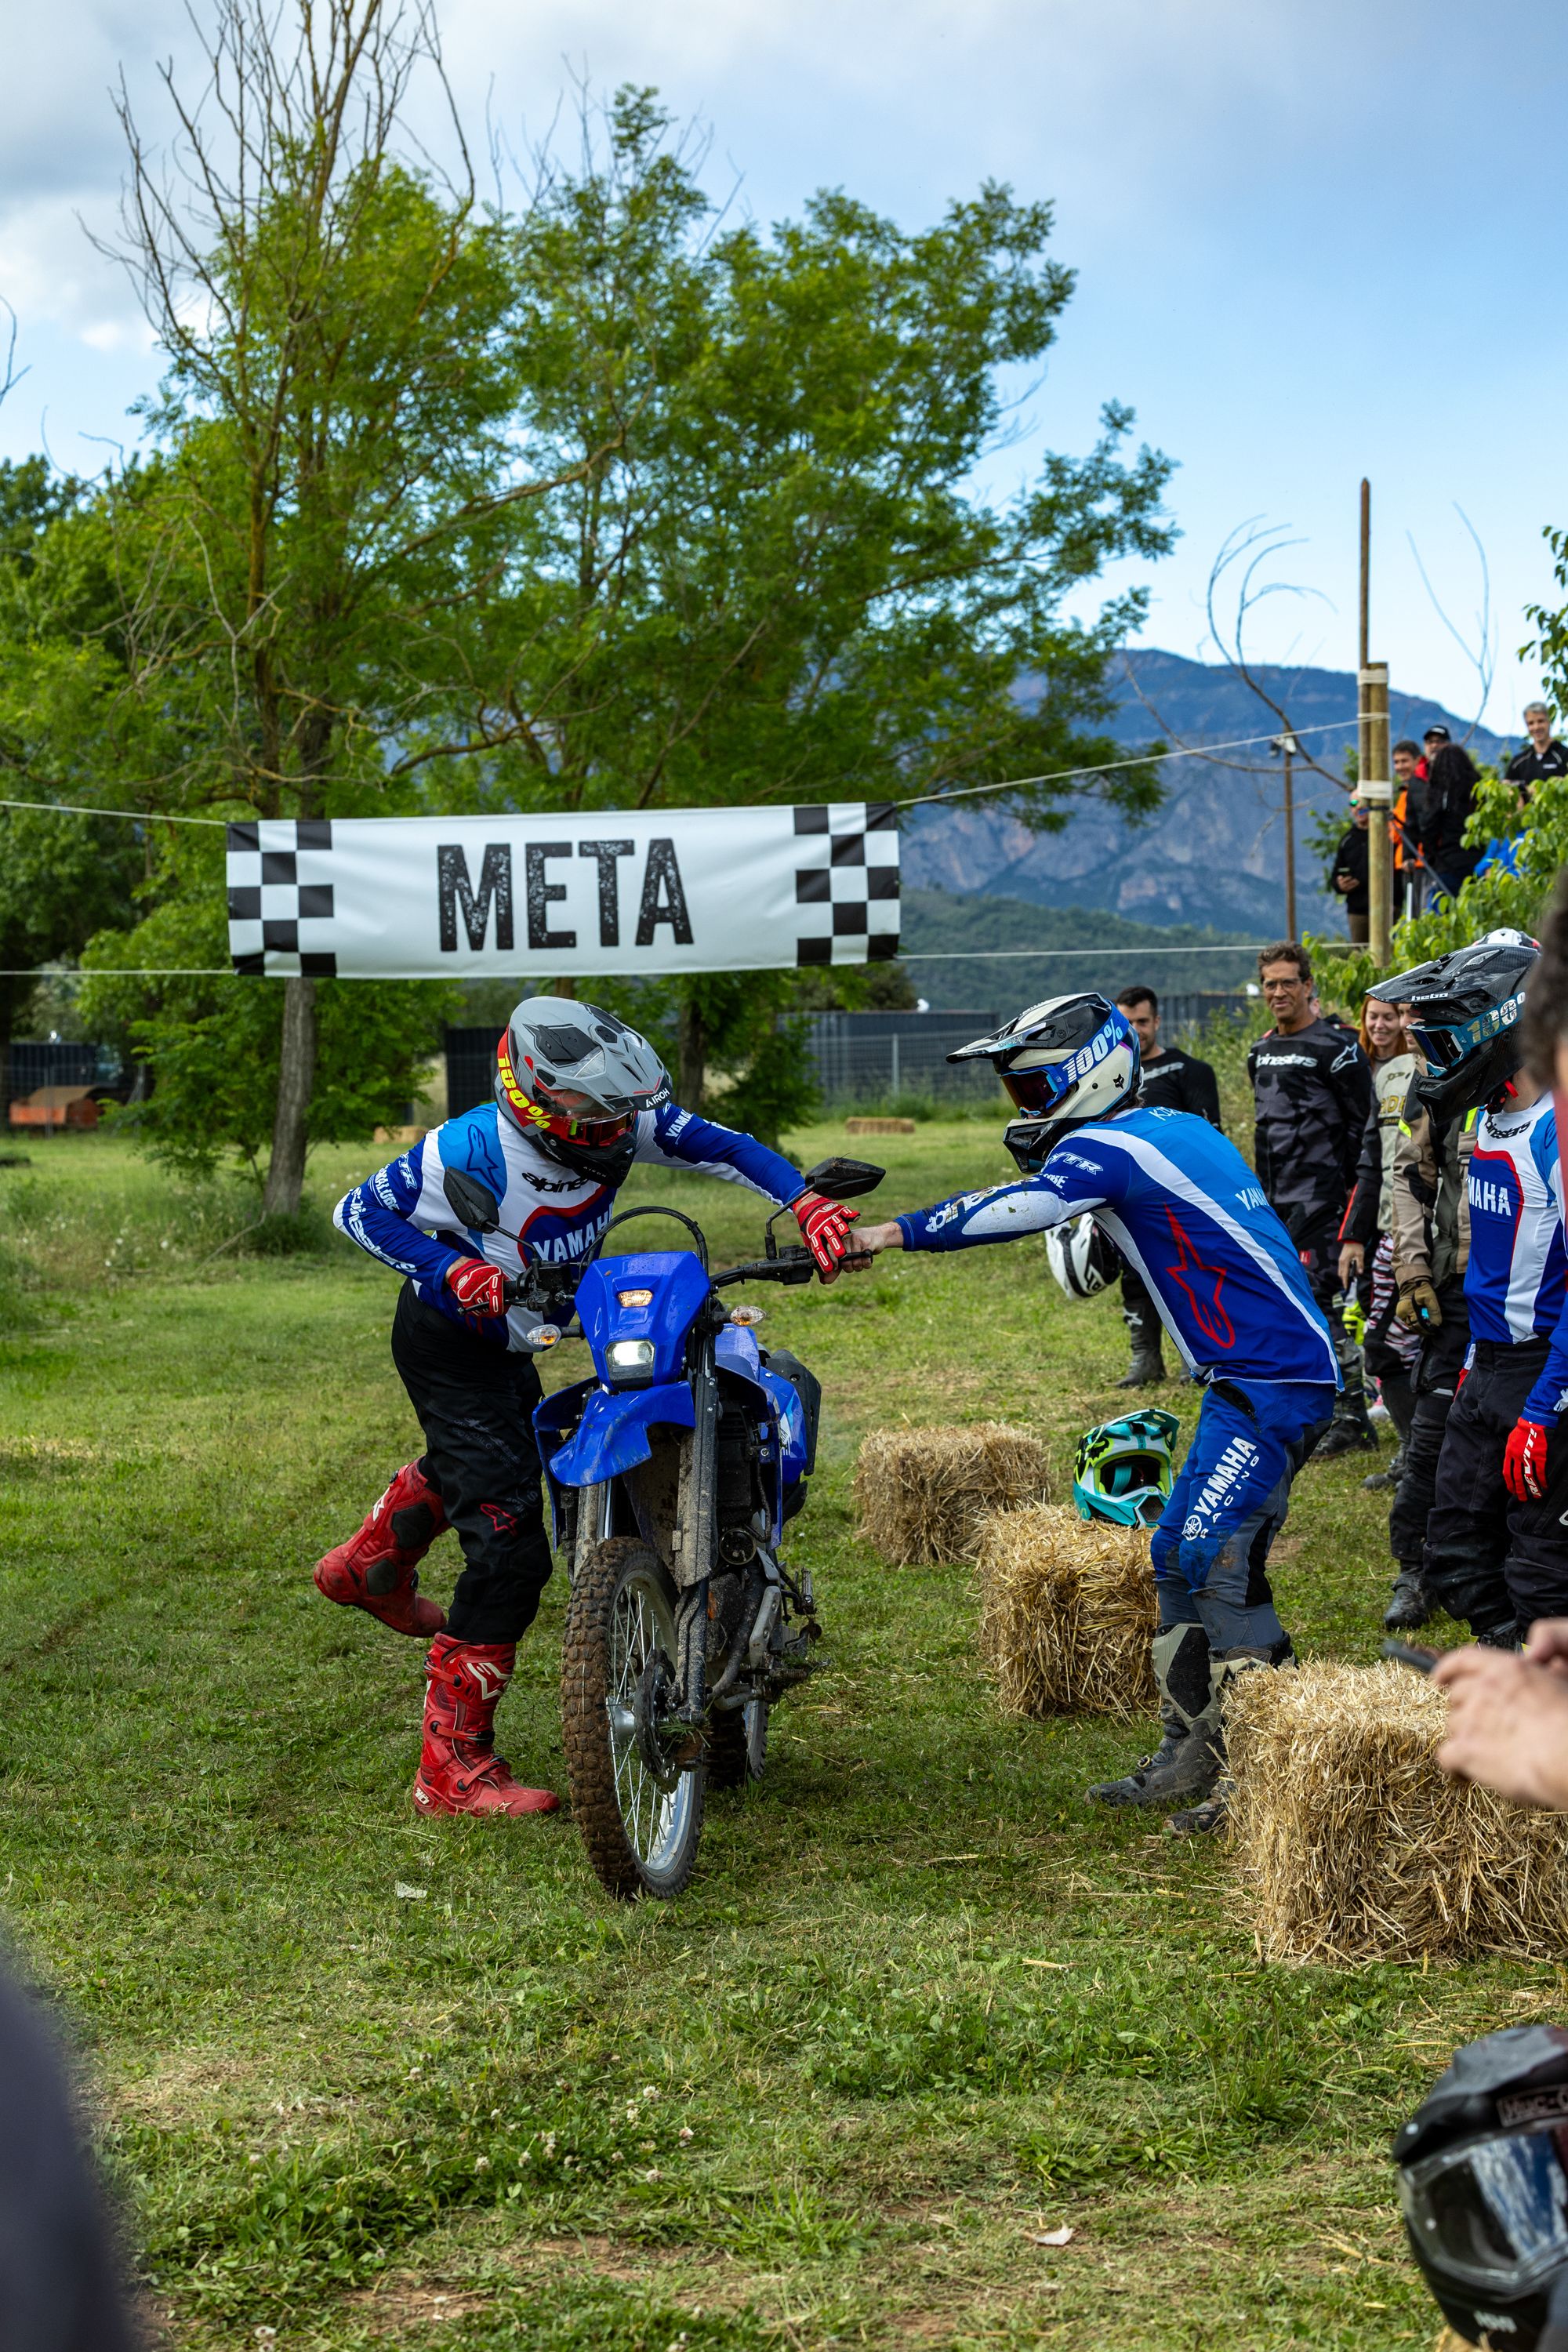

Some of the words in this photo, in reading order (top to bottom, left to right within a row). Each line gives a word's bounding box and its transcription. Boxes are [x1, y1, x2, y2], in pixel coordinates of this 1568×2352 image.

[437, 838, 695, 952] META
[1411, 992, 1449, 1002] hebo
[1467, 991, 1526, 1044] 100
[1062, 1018, 1123, 1084] 100%
[498, 1052, 553, 1129] 100%
[646, 1087, 670, 1109] AIROH
[1193, 1436, 1258, 1516] YAMAHA
[1200, 1455, 1260, 1539] RACING
